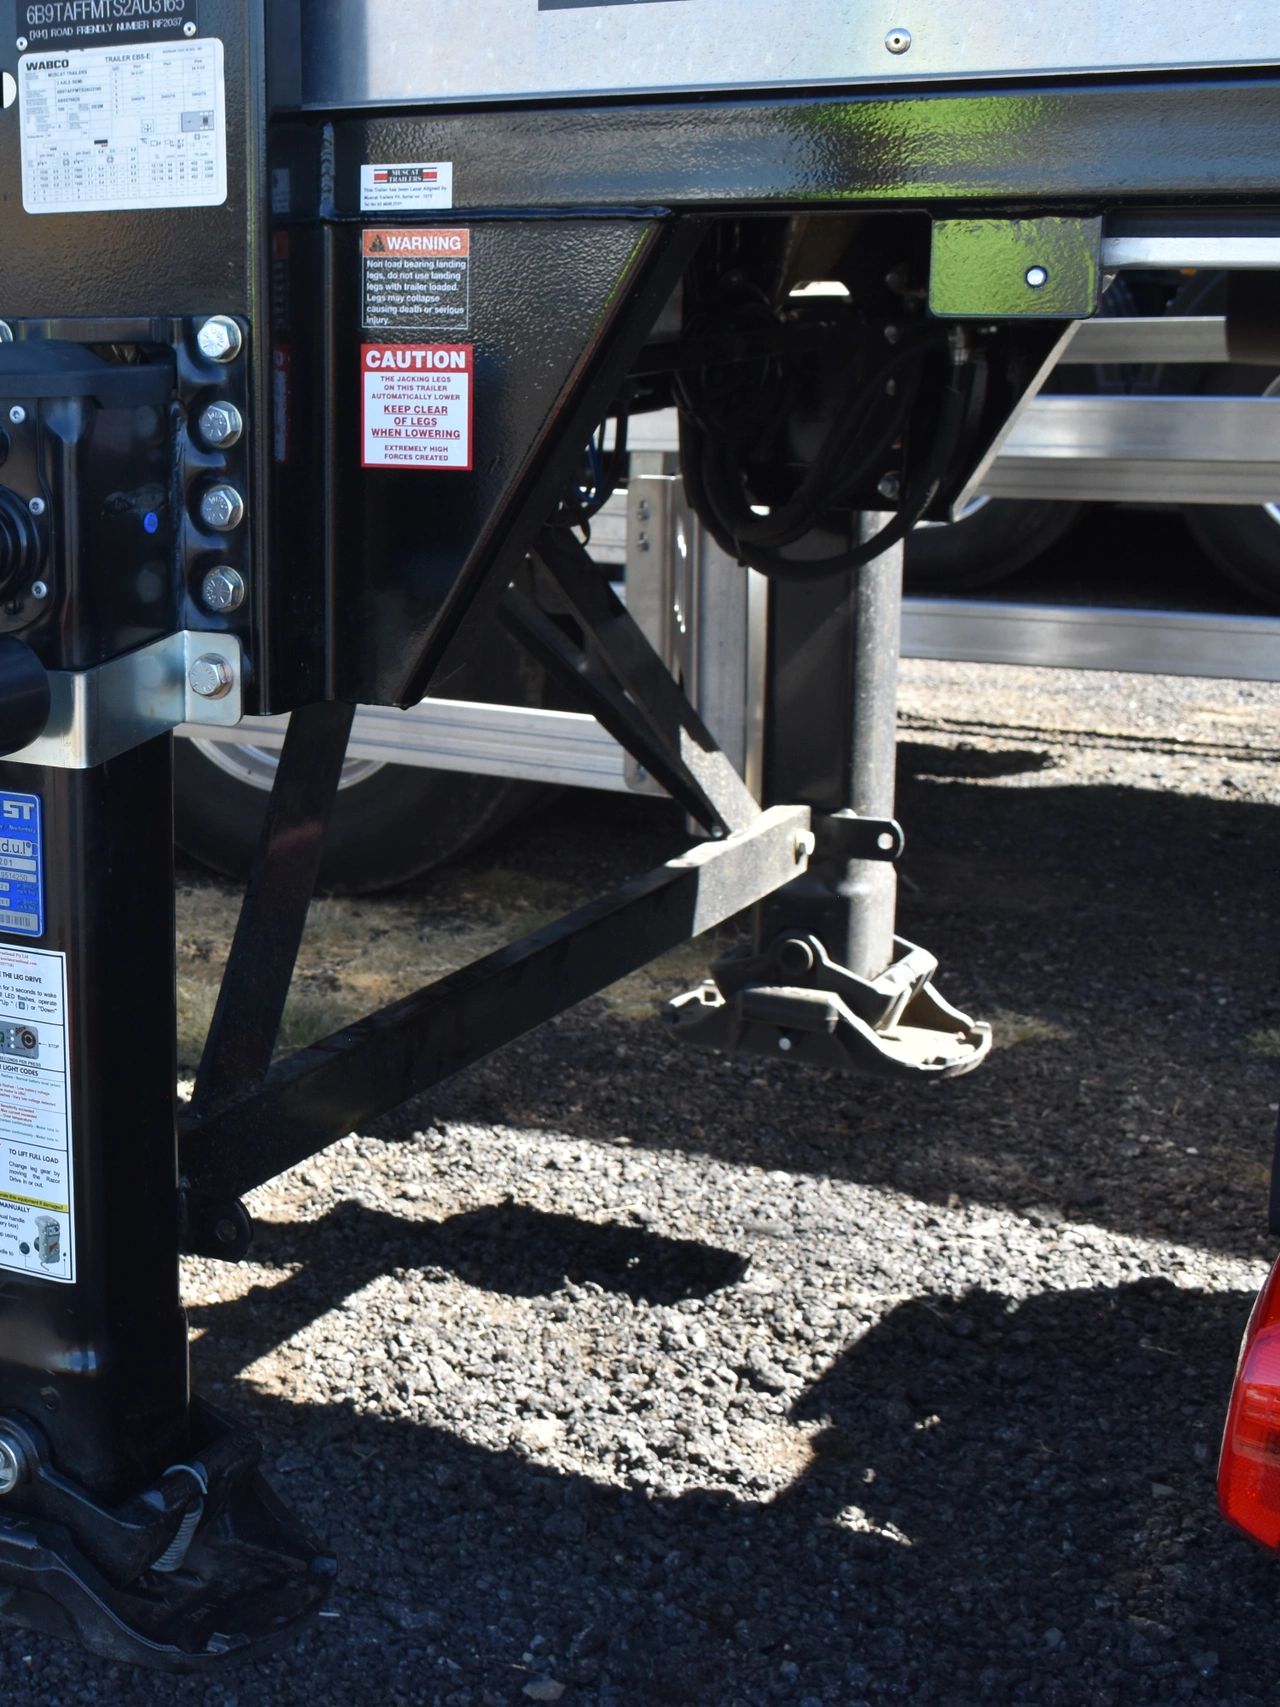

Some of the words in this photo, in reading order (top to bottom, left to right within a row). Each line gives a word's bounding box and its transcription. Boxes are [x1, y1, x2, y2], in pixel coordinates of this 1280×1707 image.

[50, 27, 73, 37] ROAD
[76, 23, 113, 35] FRIENDLY
[116, 20, 149, 31] NUMBER
[25, 59, 69, 71] WABCO
[105, 55, 131, 63] TRAILER
[389, 175, 422, 183] TRAILERS
[386, 236, 461, 250] WARNING
[366, 260, 383, 268] Non
[384, 260, 402, 268] load
[404, 260, 435, 270] bearing
[436, 260, 467, 270] landing
[387, 271, 398, 279] do
[431, 271, 461, 281] landing
[366, 283, 383, 292] legs
[385, 283, 402, 291] with
[404, 283, 427, 291] trailer
[429, 283, 459, 291] loaded.
[366, 294, 386, 303] Legs
[387, 295, 405, 303] may
[406, 294, 440, 303] collapse
[366, 305, 397, 314] causing
[399, 305, 422, 313] death
[434, 306, 464, 314] serious
[365, 350, 466, 369] CAUTION
[383, 404, 411, 414] KEEP
[413, 405, 448, 414] CLEAR
[393, 416, 408, 425] OF
[410, 417, 437, 426] LEGS
[371, 428, 402, 437] WHEN
[405, 428, 460, 438] LOWERING
[2, 971, 12, 979] THE
[13, 973, 23, 981] LEG
[24, 975, 42, 984] DRIVE
[15, 987, 36, 996] seconds
[38, 998, 57, 1007] operate
[0, 1055, 19, 1063] SECONDS
[3, 1063, 19, 1073] LIGHT
[19, 1066, 39, 1077] CODES
[17, 1150, 28, 1158] LIFT
[29, 1152, 41, 1161] FULL
[42, 1154, 59, 1164] LOAD
[9, 1161, 27, 1171] Change
[29, 1165, 38, 1173] leg
[9, 1169, 27, 1179] moving
[9, 1175, 22, 1184] Drive
[0, 1201, 31, 1213] MANUALLY
[8, 1215, 25, 1224] handle
[4, 1231, 18, 1241] using
